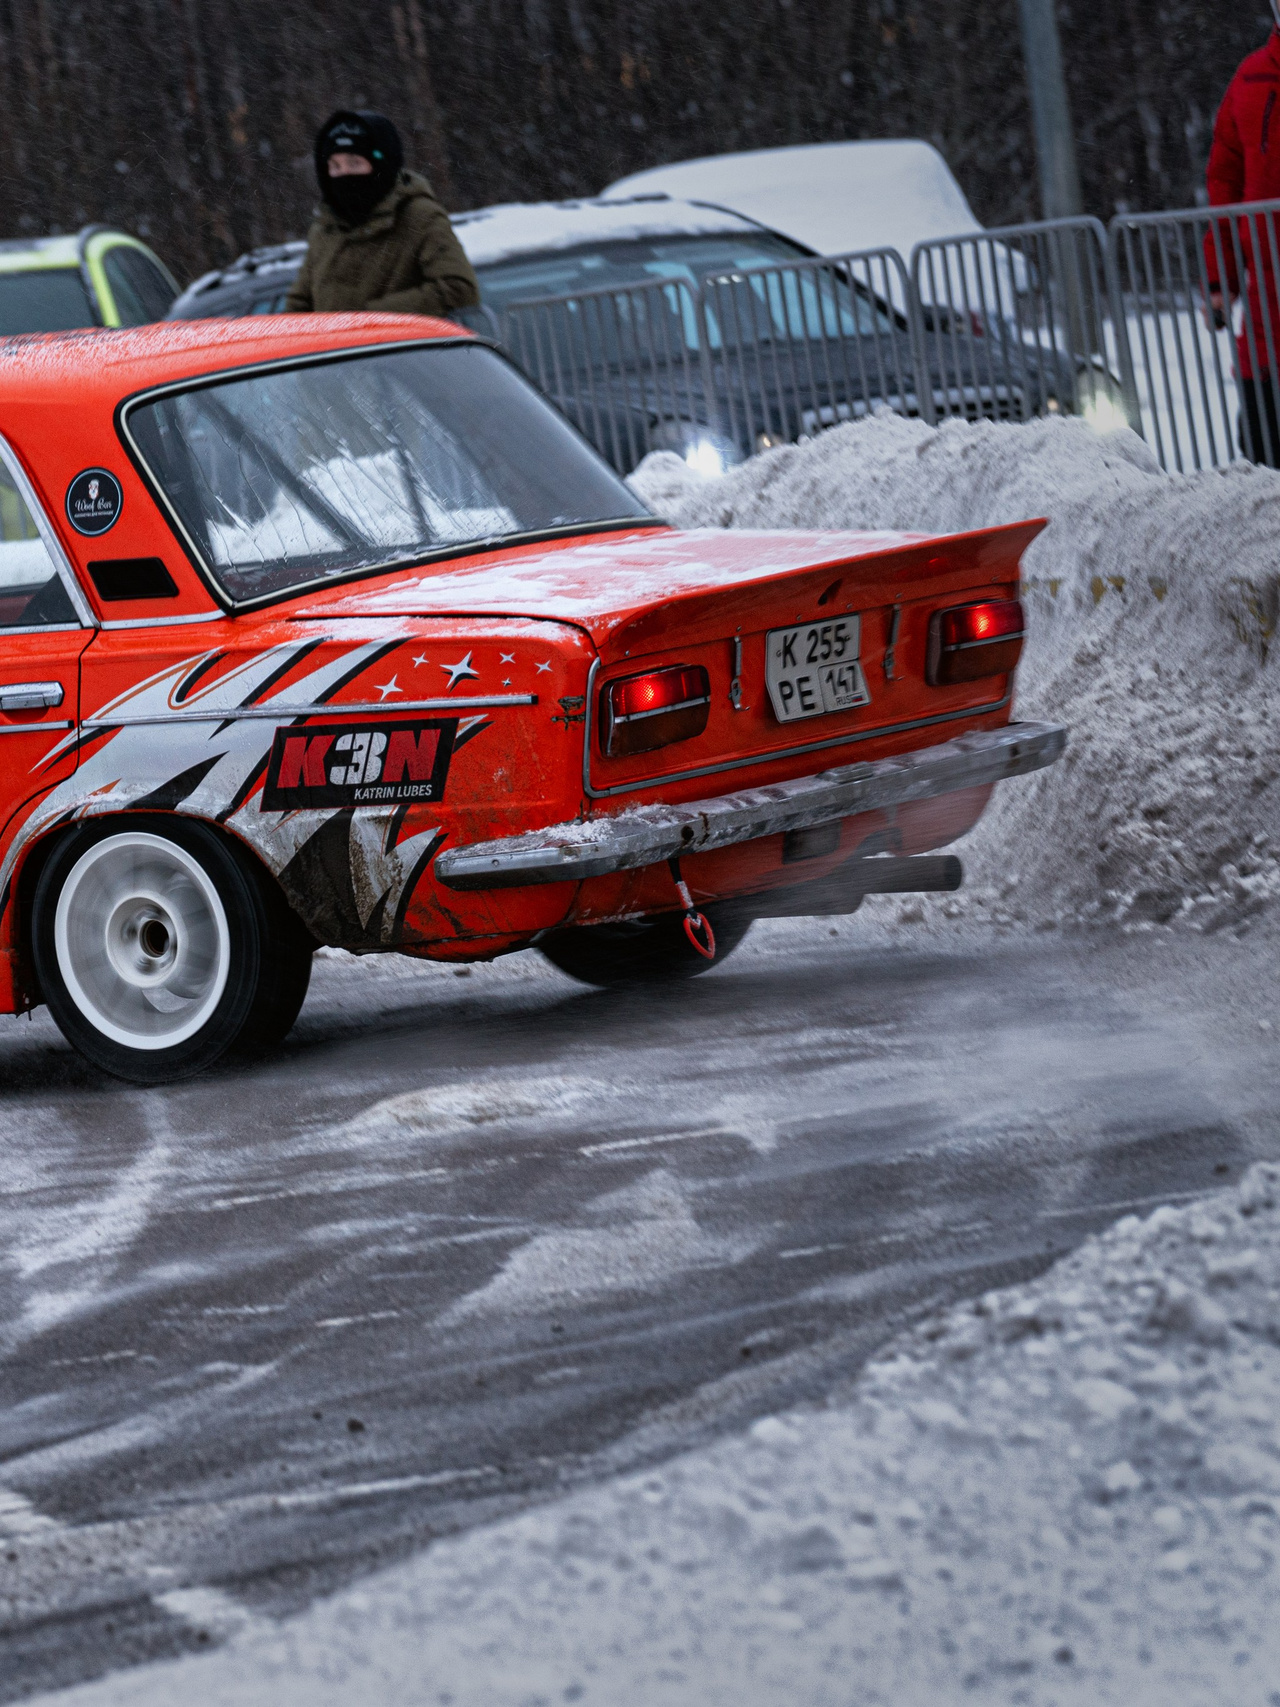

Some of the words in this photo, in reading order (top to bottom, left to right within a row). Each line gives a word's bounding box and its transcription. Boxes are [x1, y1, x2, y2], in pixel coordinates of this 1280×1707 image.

[806, 623, 846, 664] 255
[825, 665, 856, 696] 147
[836, 695, 852, 707] RUS
[276, 728, 442, 789] K3N
[354, 786, 395, 800] KATRIN
[397, 784, 432, 797] LUBES
